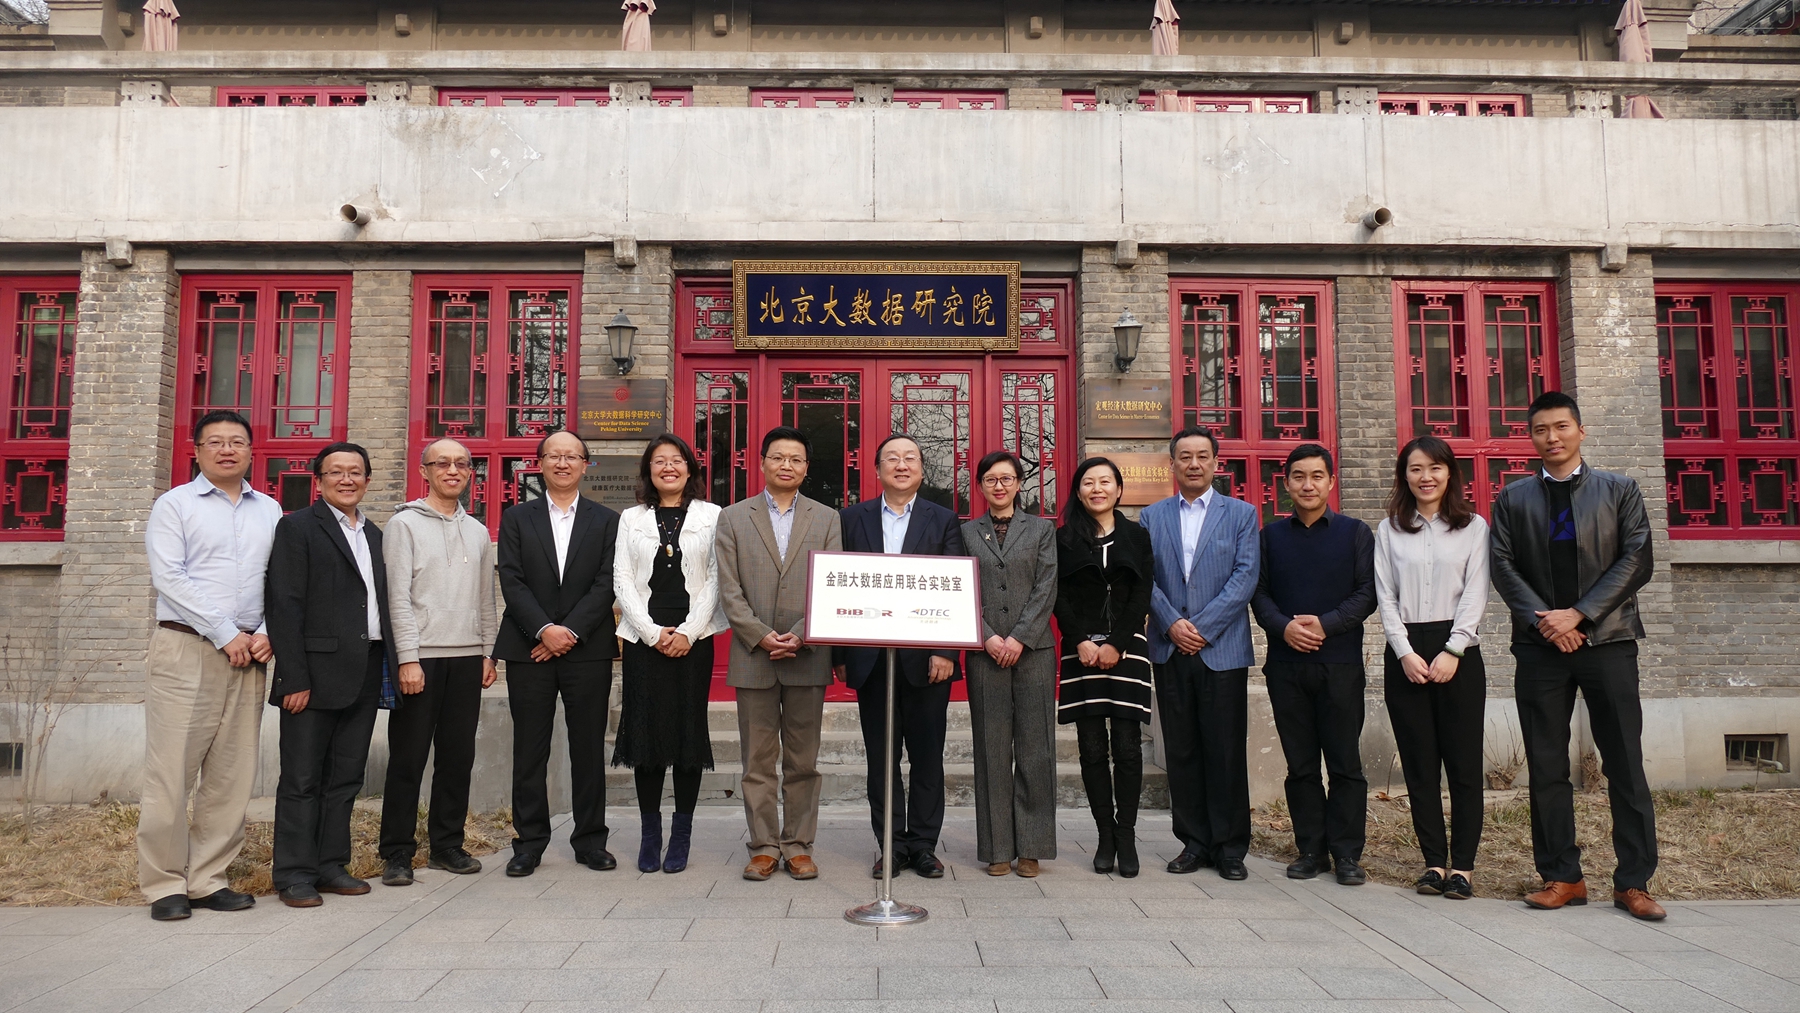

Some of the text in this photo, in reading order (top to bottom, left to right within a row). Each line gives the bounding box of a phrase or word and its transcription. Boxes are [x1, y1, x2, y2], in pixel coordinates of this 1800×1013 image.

[759, 285, 996, 327] 北京大数据研究院
[1096, 400, 1162, 411] 宏观经济大数据研究中心
[581, 410, 662, 419] 北京大学大数据科学研究中心
[826, 571, 962, 591] 金融大数据应用联合实验室
